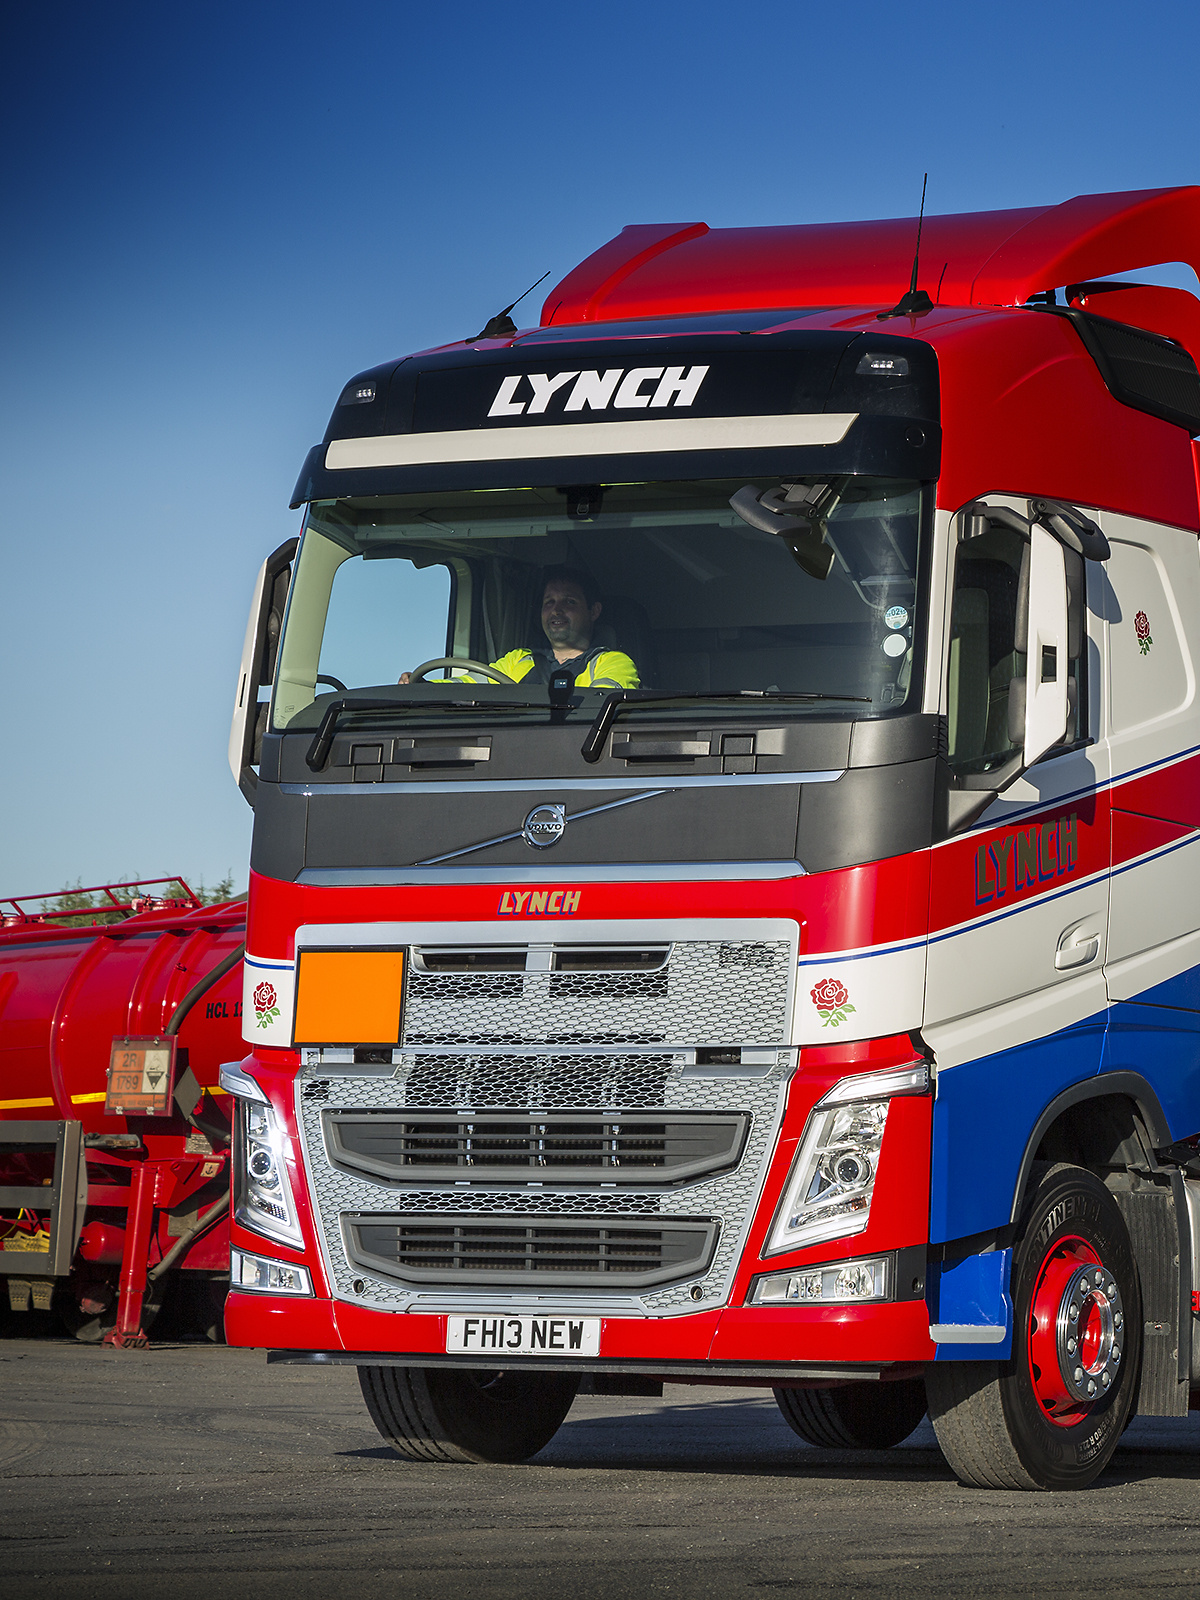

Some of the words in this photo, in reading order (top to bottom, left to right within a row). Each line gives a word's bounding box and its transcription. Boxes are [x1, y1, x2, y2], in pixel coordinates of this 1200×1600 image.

[487, 366, 710, 417] LYNCH
[527, 823, 562, 831] VOLVO
[975, 812, 1078, 907] LYNCH
[497, 890, 582, 915] LYNCH
[205, 1002, 228, 1019] HCL
[122, 1053, 138, 1068] 2R
[116, 1075, 139, 1091] 1789
[463, 1319, 522, 1348] FH13
[530, 1320, 584, 1349] NEW
